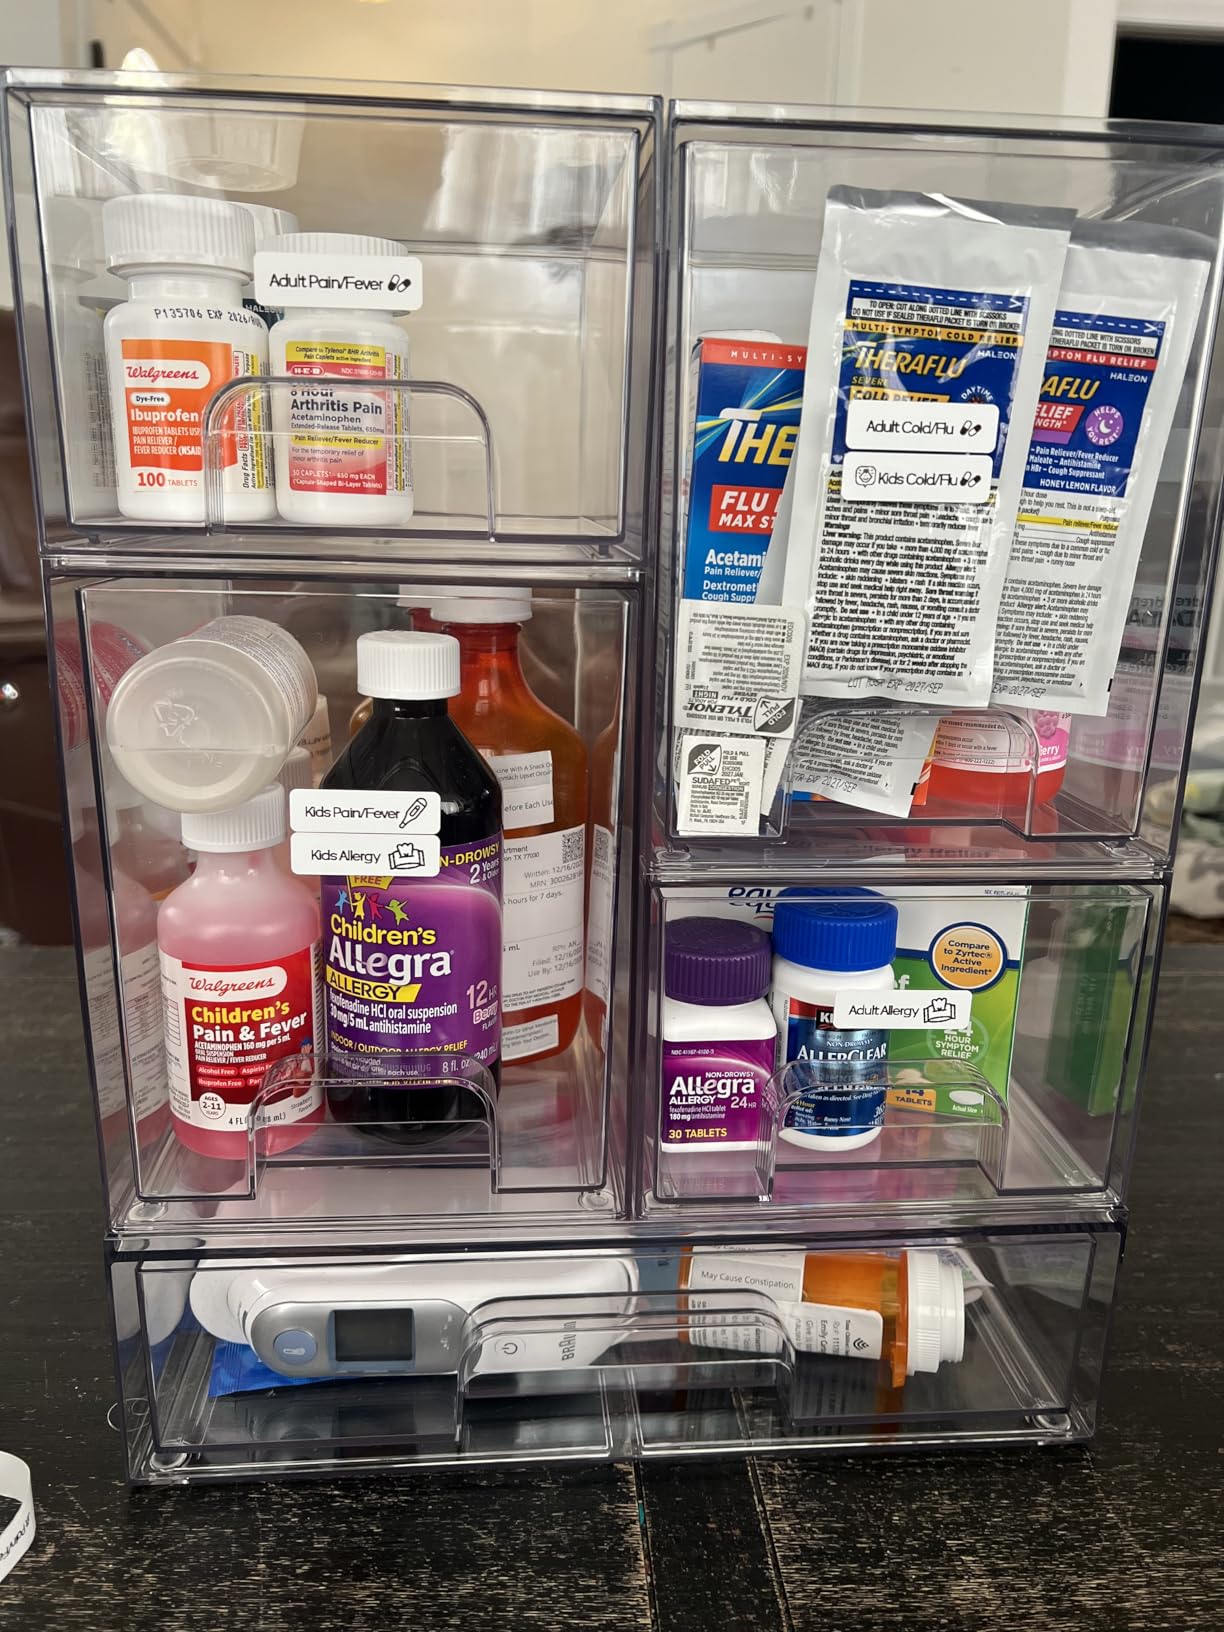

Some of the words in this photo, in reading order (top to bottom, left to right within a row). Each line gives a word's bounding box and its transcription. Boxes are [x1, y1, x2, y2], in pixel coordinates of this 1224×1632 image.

[269, 274, 308, 289] Adult
[310, 274, 383, 291] Pain/Fever
[154, 308, 203, 320] P135706
[207, 310, 223, 320] EXP
[893, 312, 915, 320] SEALED
[916, 314, 943, 323] THERAFLU
[944, 316, 964, 325] PACKET
[947, 332, 974, 341] COLD
[1065, 331, 1083, 339] DOTTED
[1085, 332, 1099, 340] LINE
[1100, 333, 1113, 342] WITH
[1114, 335, 1141, 345] SCISSORS
[1052, 338, 1079, 346] THERAFLU
[1081, 340, 1100, 348] PACKET
[1102, 341, 1107, 349] IS
[1109, 342, 1123, 351] TORN
[1133, 345, 1154, 355] BROKEN
[731, 350, 803, 363] MULTI-SY
[855, 341, 968, 378] THERAFLU
[977, 350, 1016, 360] HALEON
[1087, 355, 1105, 363] FLU
[1110, 357, 1148, 367] RELIEF
[126, 366, 199, 382] Walgreens
[1110, 372, 1148, 383] HALEON
[852, 376, 888, 386] SEVERE
[135, 395, 165, 404] Dye-Free
[960, 385, 993, 401] DAYTIME
[291, 400, 348, 412] Arthritis
[353, 402, 382, 415] Pain
[1094, 406, 1121, 419] HELPS
[131, 409, 198, 423] Ibuprofen
[291, 413, 361, 424] Acetaminophen
[132, 427, 163, 435] IBUPROFEN
[164, 427, 189, 436] TABLETS
[291, 423, 339, 431] Extended-Release
[341, 425, 363, 433] Tablets,
[866, 420, 900, 433] Adult
[902, 421, 954, 434] Cold/Flu
[133, 436, 146, 445] PAIN
[147, 436, 173, 445] RELIEVER
[308, 435, 352, 443] Reliever/Fever
[354, 438, 379, 446] Reducer
[719, 408, 801, 466] THE
[134, 446, 150, 455] FEVER
[151, 446, 177, 455] REDUCER
[311, 448, 340, 457] temporary
[1036, 446, 1049, 454] Pain
[1051, 448, 1094, 460] Reliever/Fever
[1094, 451, 1118, 463] Reducer
[1030, 455, 1052, 464] Maleate
[1059, 458, 1101, 469] Antihistamine
[878, 472, 904, 485] Kids
[906, 473, 958, 486] Cold/Flu
[1048, 466, 1067, 476] Cough
[1069, 469, 1105, 479] Suppressant
[137, 472, 165, 487] 100
[168, 479, 198, 487] TABLETS
[1040, 478, 1065, 488] HONEY
[1066, 481, 1090, 490] LEMON
[1090, 483, 1117, 493] FLAVOR
[720, 491, 769, 513] FLU
[719, 514, 754, 528] MAX
[705, 549, 767, 567] Acetami
[704, 567, 722, 575] Pain
[724, 567, 761, 578] Reliever/
[702, 592, 729, 602] Cough
[905, 681, 943, 694] 2027/SEP
[1009, 685, 1046, 698] 2027/SEP
[762, 703, 780, 718] PULL
[768, 709, 786, 726] FOLD
[694, 749, 711, 765] FOLD
[700, 755, 716, 769] PULL
[692, 776, 731, 785] SUDAFED
[525, 801, 540, 810] Each
[305, 806, 331, 818] Kids
[332, 807, 400, 819] Pain/Fever
[311, 849, 337, 862] Kids
[339, 851, 381, 865] Allergy
[440, 841, 500, 867] N-DROWSY
[470, 864, 481, 884] 2
[353, 875, 382, 887] FREE
[509, 894, 528, 905] hours
[330, 913, 437, 946] Children's
[948, 940, 990, 951] Compare
[328, 935, 452, 986] Allegra
[955, 949, 993, 959] Zyrtec®
[952, 958, 982, 967] Active
[189, 976, 276, 997] Walgreens
[328, 969, 402, 1001] ALLERGY
[466, 980, 488, 1010] 12
[191, 1001, 290, 1025] Children's
[388, 1006, 406, 1019] oral
[408, 1002, 458, 1020] suspension
[848, 1004, 880, 1017] Adult
[880, 1005, 920, 1020] Allergy
[193, 1024, 234, 1043] Pain
[239, 1025, 255, 1041] &
[260, 1011, 308, 1038] Fever
[369, 1019, 432, 1034] antihistamine
[194, 1041, 242, 1051] ACETAMINOPHEN
[243, 1040, 255, 1050] 160
[266, 1037, 277, 1048] per
[944, 1035, 971, 1044] HOUR
[935, 1040, 979, 1053] SYMPTOM
[246, 1053, 267, 1062] REDUCER
[940, 1048, 972, 1059] RELIEF
[198, 1066, 219, 1075] Alcohol
[220, 1067, 235, 1075] Free
[241, 1065, 265, 1074] Aspirin
[198, 1078, 226, 1087] Ibuprofen
[228, 1079, 242, 1087] Free
[669, 1076, 755, 1098] Allegra
[202, 1102, 222, 1111] 2-11
[669, 1095, 716, 1105] ALLERGY
[730, 1096, 747, 1108] 24
[895, 1095, 933, 1106] TABLETS
[952, 1104, 966, 1113] Actual
[669, 1130, 682, 1138] 30
[685, 1128, 727, 1138] TABLETS
[701, 1270, 718, 1280] May
[719, 1272, 744, 1284] Cause
[744, 1275, 795, 1290] Constipation.
